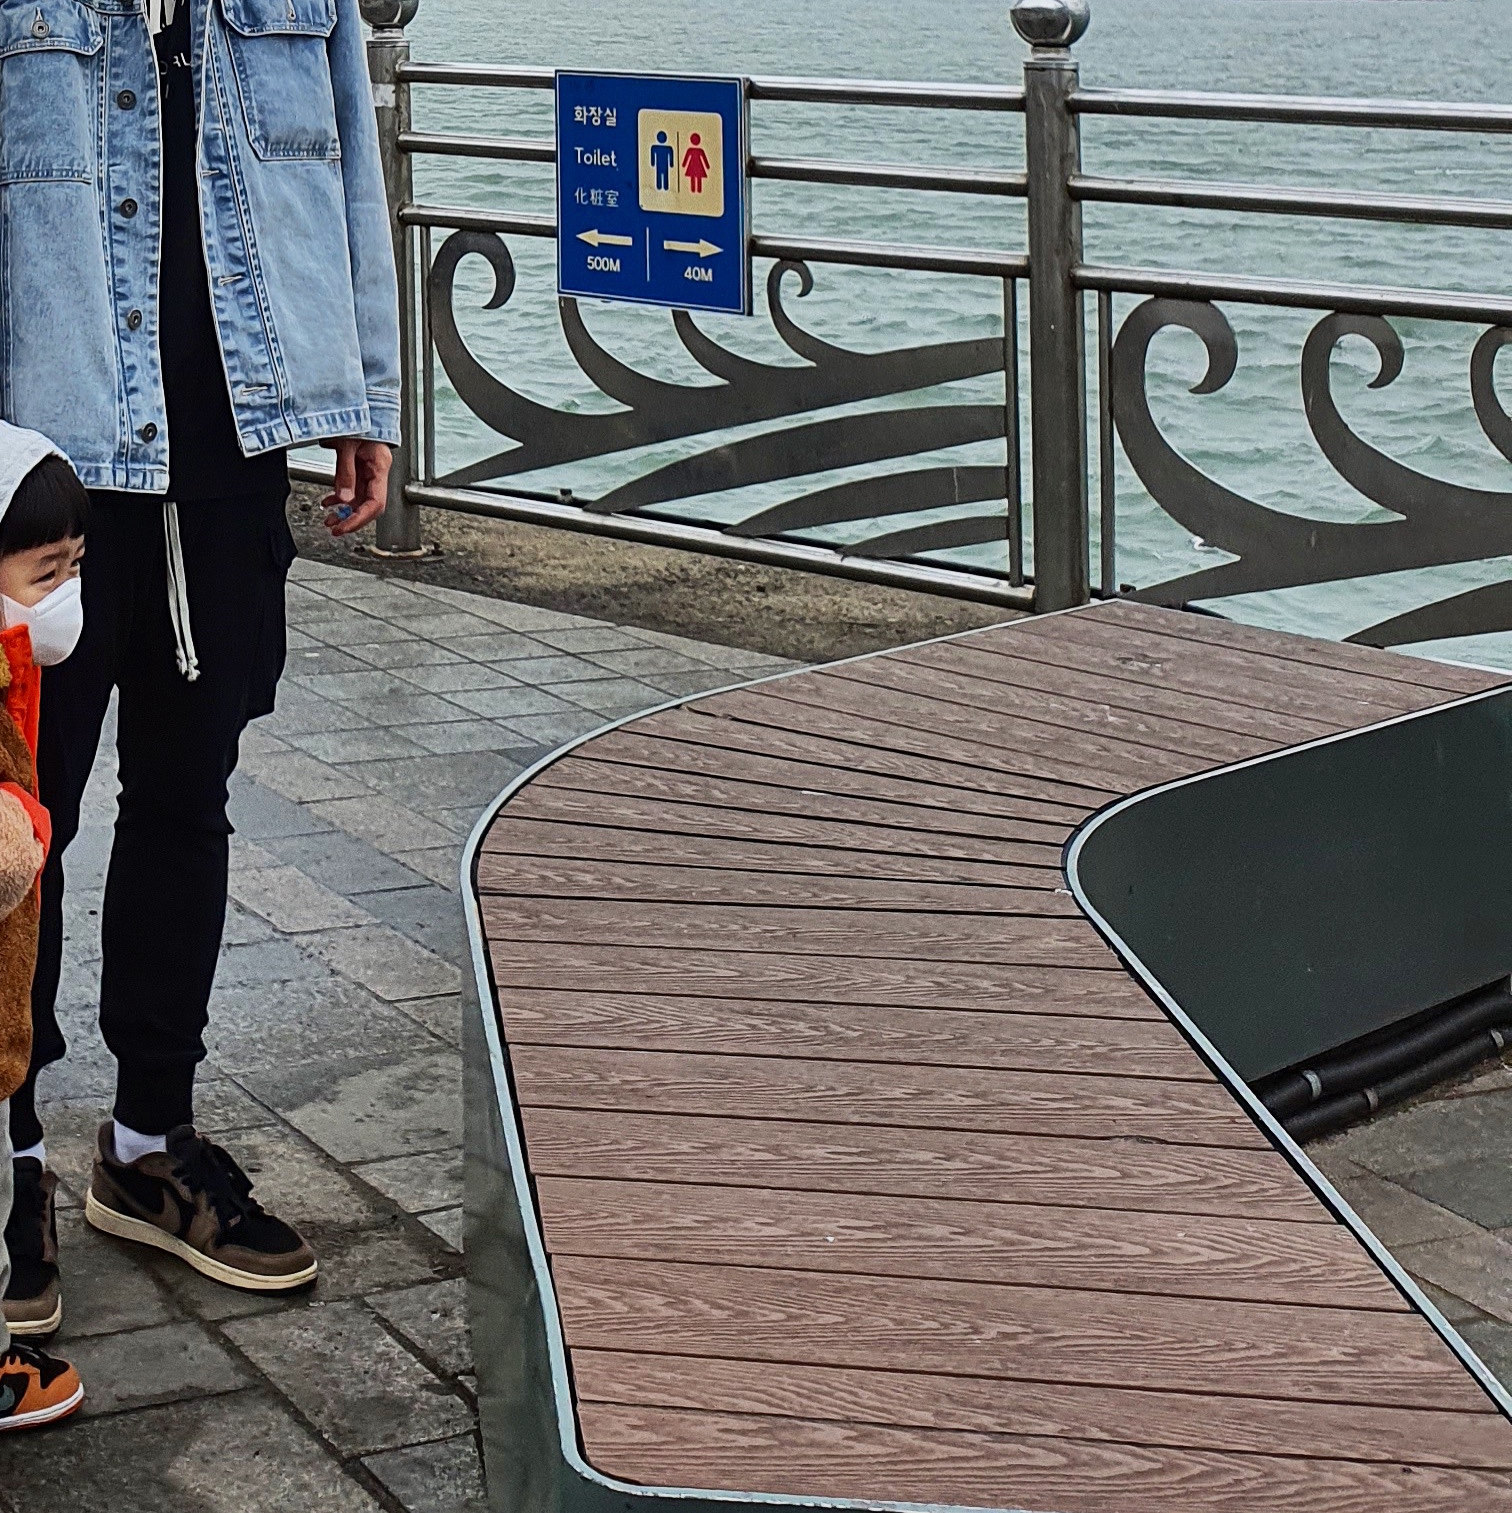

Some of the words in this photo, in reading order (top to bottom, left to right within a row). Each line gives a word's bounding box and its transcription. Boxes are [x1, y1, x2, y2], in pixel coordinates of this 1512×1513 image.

[574, 105, 617, 127] 화장실
[574, 147, 617, 167] Toilet
[587, 256, 621, 273] 500M
[684, 266, 713, 283] 40M
